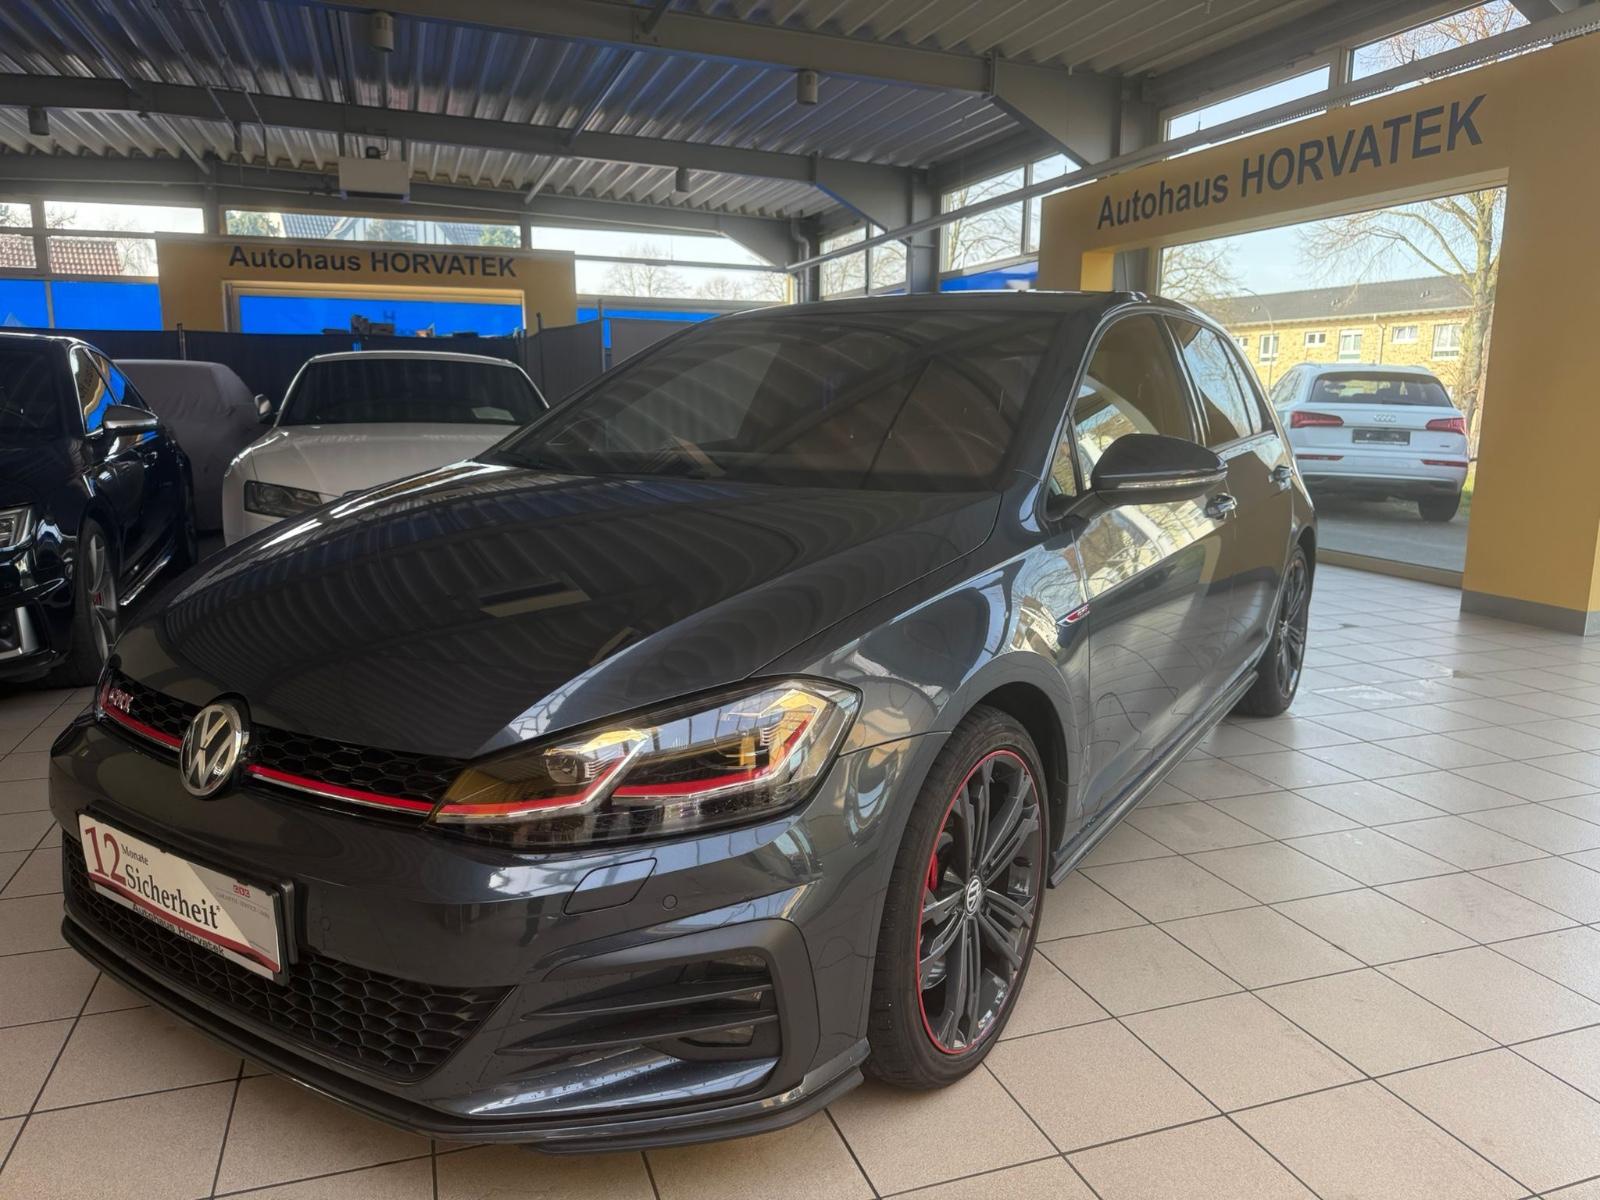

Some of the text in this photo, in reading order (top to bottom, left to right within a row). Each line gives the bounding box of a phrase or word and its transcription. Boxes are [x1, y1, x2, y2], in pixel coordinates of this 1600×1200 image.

[1097, 94, 1488, 230] Autohaus HORVATEK
[229, 245, 517, 278] Autohaus HORVATEK
[85, 827, 127, 887] 12
[121, 843, 149, 866] Monate
